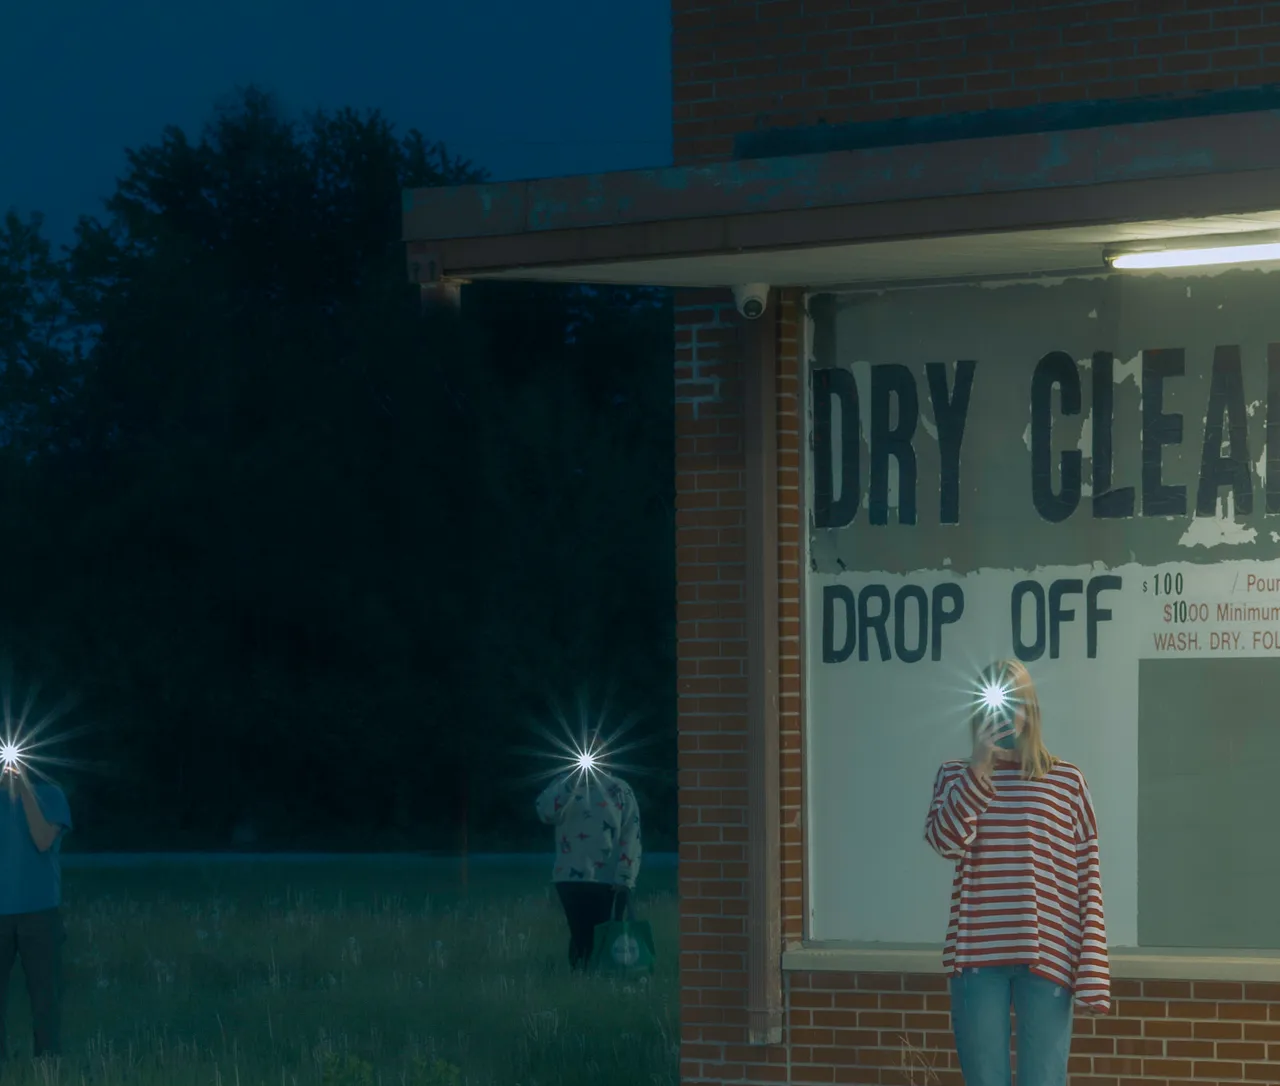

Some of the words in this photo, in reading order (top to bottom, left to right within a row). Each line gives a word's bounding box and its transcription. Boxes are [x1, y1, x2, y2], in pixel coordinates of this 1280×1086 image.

[813, 359, 977, 528] DRY
[823, 583, 964, 662] DROP
[1011, 575, 1123, 661] OFF
[1153, 632, 1202, 651] WASH.
[1209, 632, 1245, 650] DRY.
